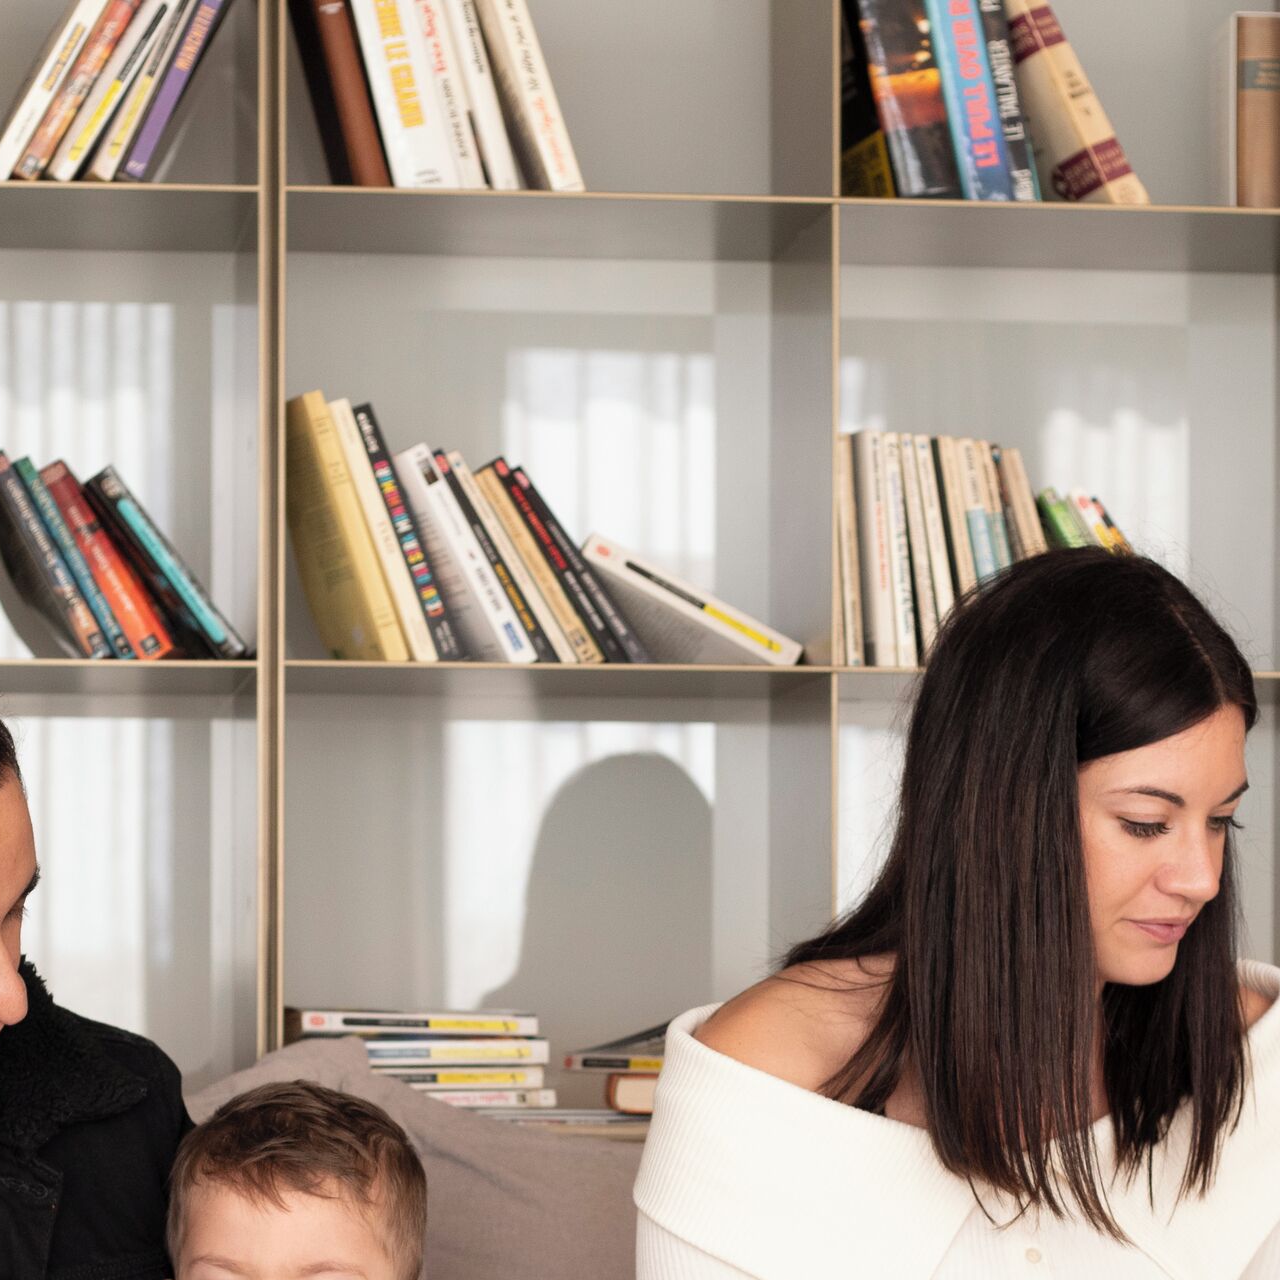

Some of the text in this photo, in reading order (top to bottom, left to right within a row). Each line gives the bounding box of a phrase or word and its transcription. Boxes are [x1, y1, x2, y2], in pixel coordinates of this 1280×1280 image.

[384, 40, 410, 62] LE
[949, 0, 1000, 167] LE PULL OVER R
[987, 39, 1019, 119] TAILLANTER
[390, 60, 425, 128] GRAND
[1003, 122, 1024, 141] LE
